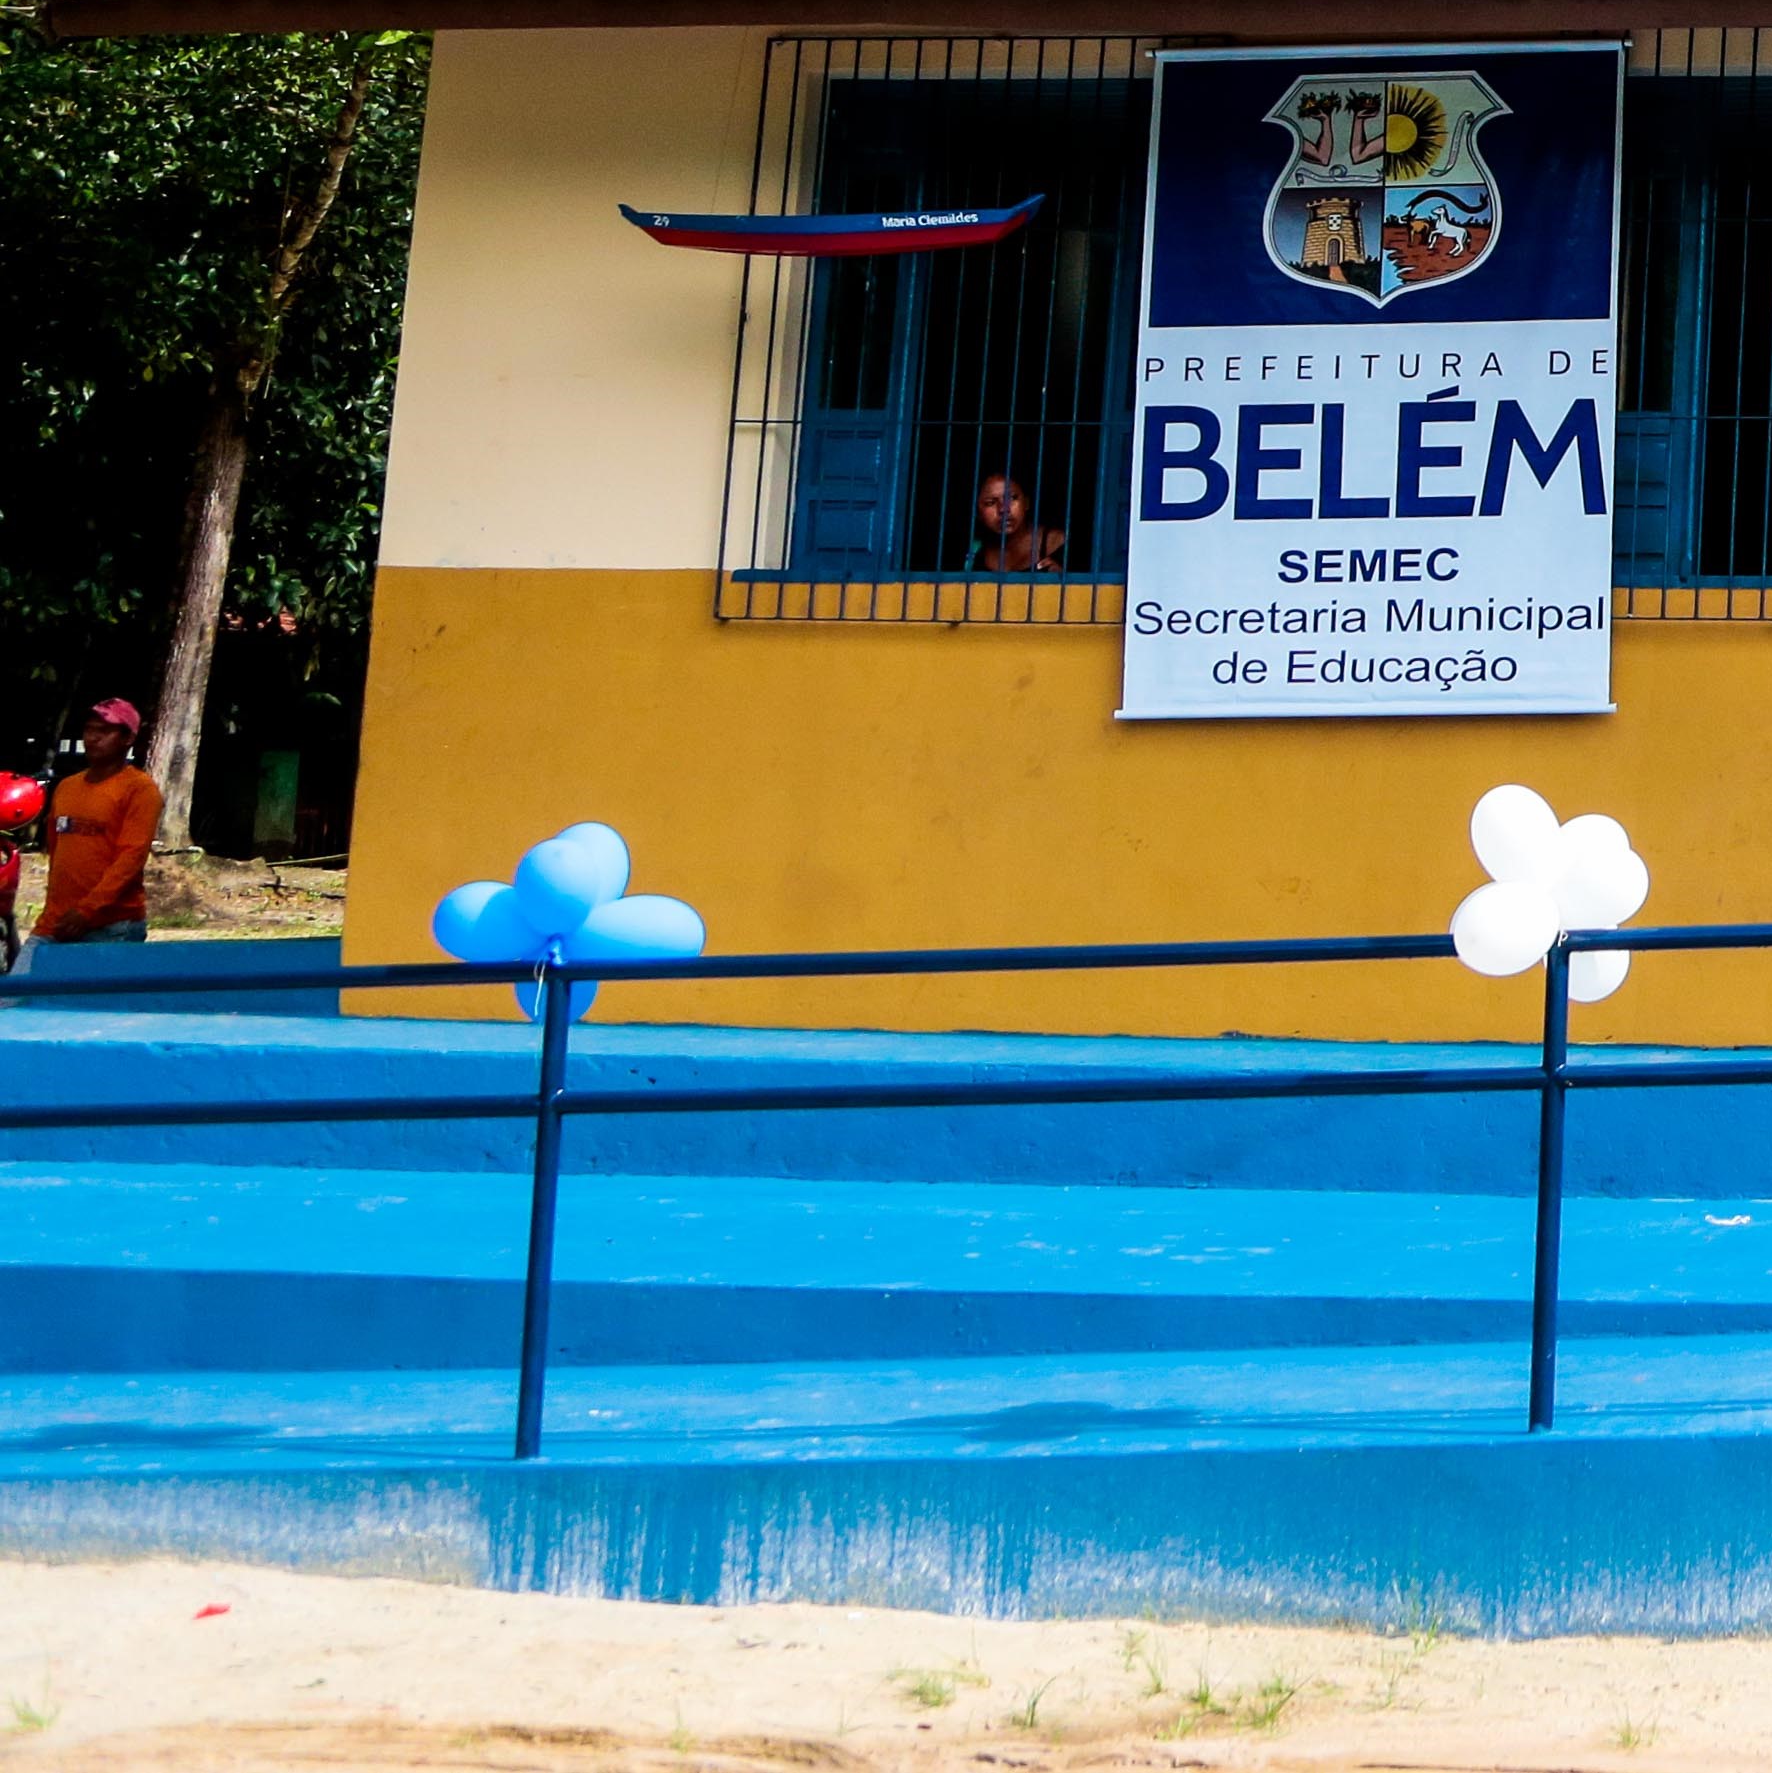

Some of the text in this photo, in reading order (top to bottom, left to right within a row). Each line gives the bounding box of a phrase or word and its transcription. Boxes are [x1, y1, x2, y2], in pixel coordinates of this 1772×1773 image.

[881, 212, 979, 228] Maria Clemildes
[1144, 348, 1609, 382] PREFEITURA DE
[1138, 386, 1608, 522] BELÉM
[1277, 547, 1460, 584] SEMEC
[1133, 596, 1605, 639] Secretaria Municipal
[1211, 649, 1517, 692] de Educação
